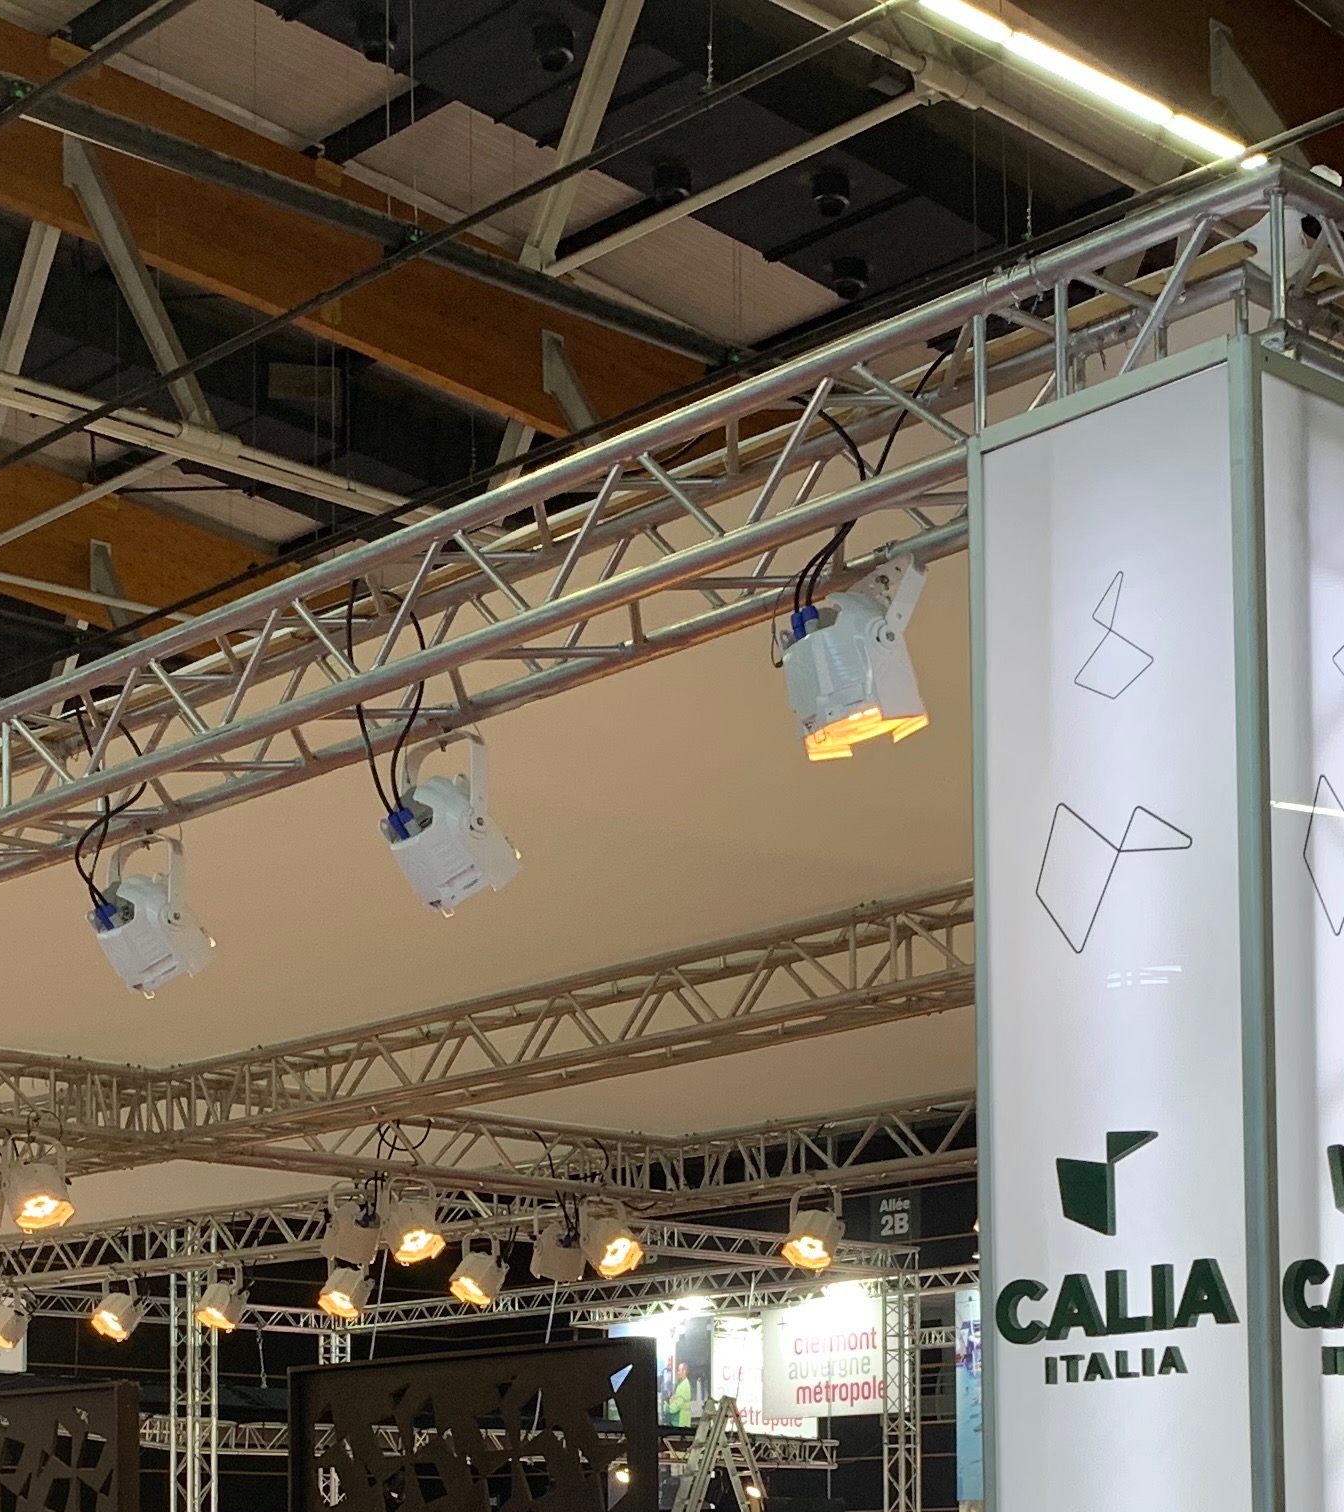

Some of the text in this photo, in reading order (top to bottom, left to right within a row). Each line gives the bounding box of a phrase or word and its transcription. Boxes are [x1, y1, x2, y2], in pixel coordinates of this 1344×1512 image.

[879, 1197, 910, 1212] Allée
[880, 1213, 909, 1236] 2B
[995, 1257, 1241, 1345] CALIA
[788, 1355, 871, 1380] auvergne
[1044, 1345, 1189, 1385] ITALIA
[796, 1375, 887, 1407] métropole
